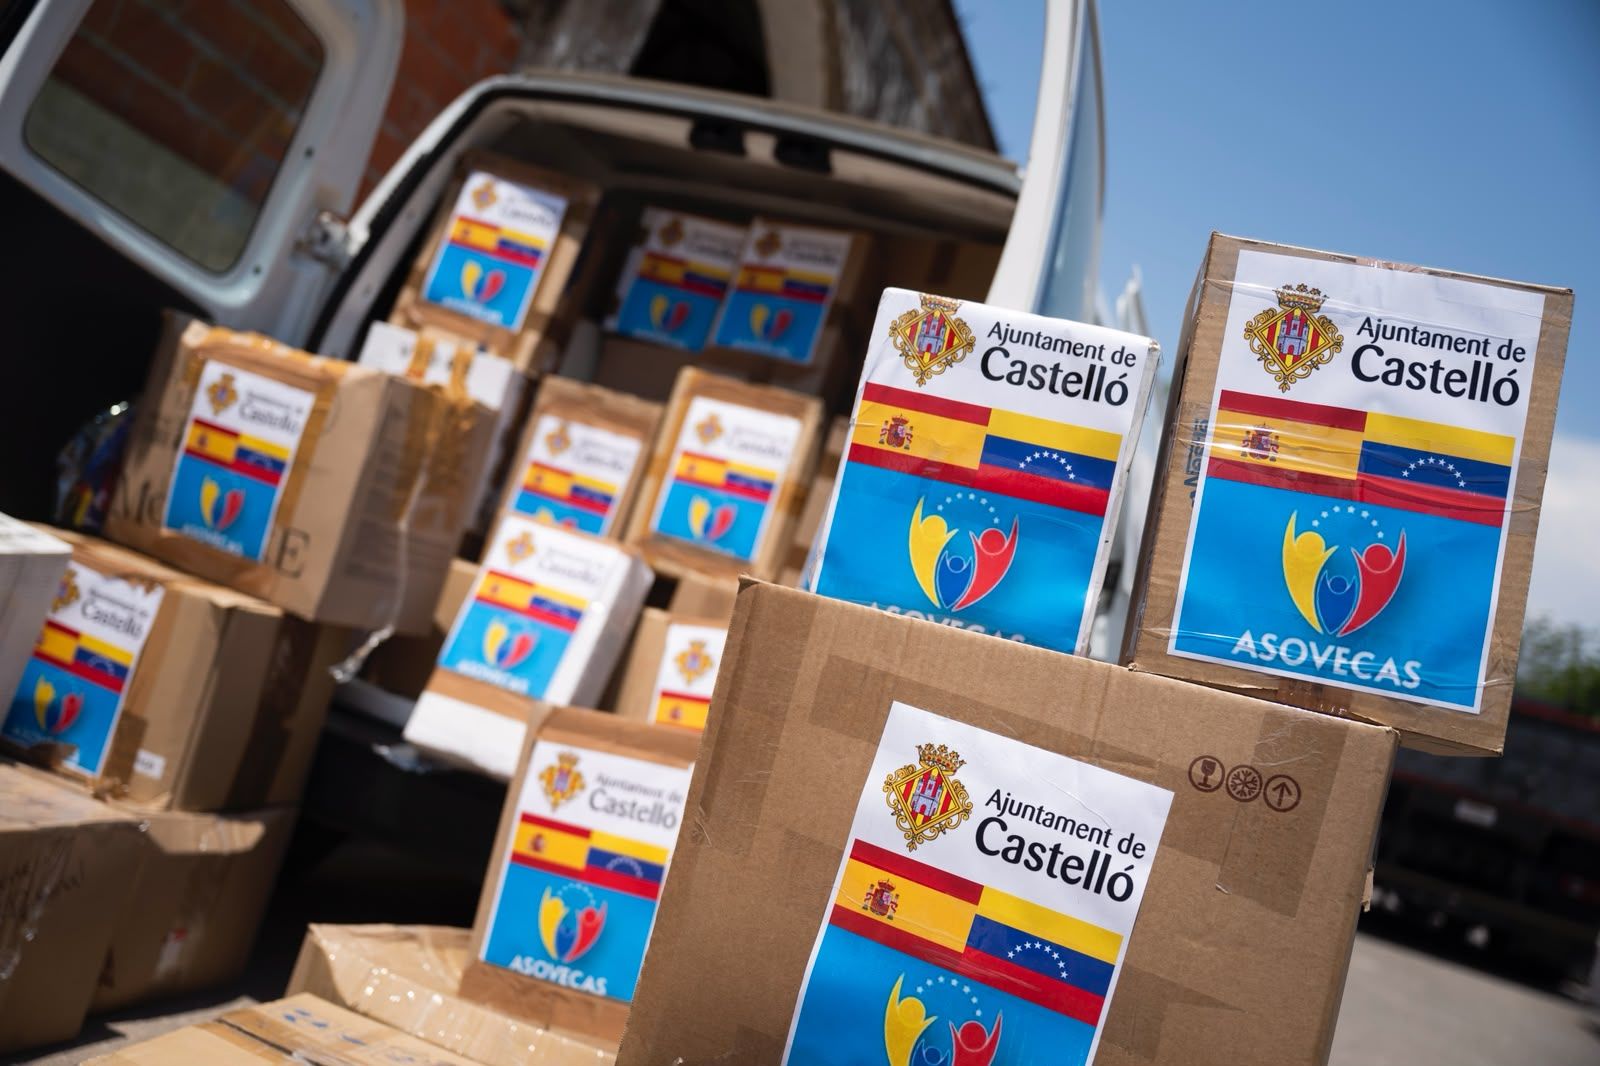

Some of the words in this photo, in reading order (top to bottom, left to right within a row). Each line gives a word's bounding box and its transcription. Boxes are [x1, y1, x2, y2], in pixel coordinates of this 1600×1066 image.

[987, 321, 1105, 362] Ajuntament
[1111, 345, 1137, 367] de
[1357, 317, 1491, 357] Ajuntament
[1497, 338, 1526, 363] de
[980, 346, 1129, 406] Castelló
[1351, 344, 1520, 406] Castelló
[1231, 629, 1422, 690] ASOVECAS
[588, 788, 678, 830] Castelló
[985, 788, 1112, 848] Ajuntament
[1117, 832, 1146, 858] de
[974, 816, 1134, 902] Castelló
[508, 954, 608, 996] ASOVECAS
